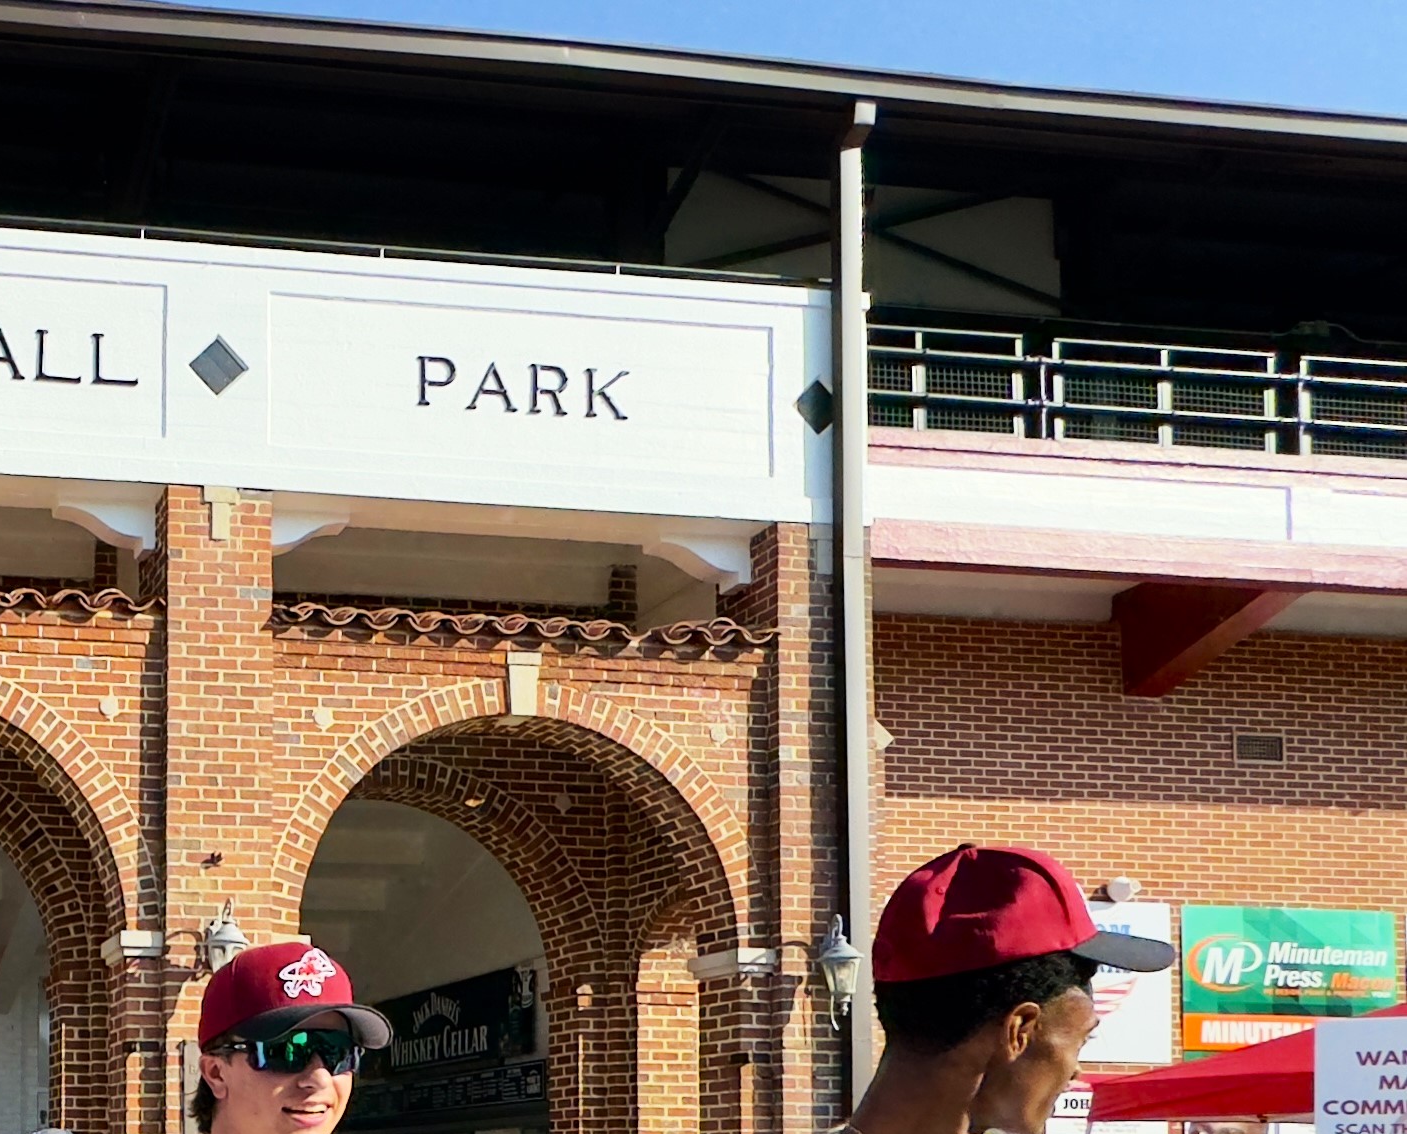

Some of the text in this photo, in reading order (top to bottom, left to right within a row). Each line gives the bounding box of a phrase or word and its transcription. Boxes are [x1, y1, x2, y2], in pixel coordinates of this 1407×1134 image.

[415, 355, 631, 421] PARK
[1268, 941, 1388, 967] Minuteman
[1263, 964, 1328, 988] Press.
[391, 1025, 488, 1067] WHISKEY CELLAR
[1323, 1099, 1407, 1116] COMM
[1335, 1123, 1385, 1134] SCAN
